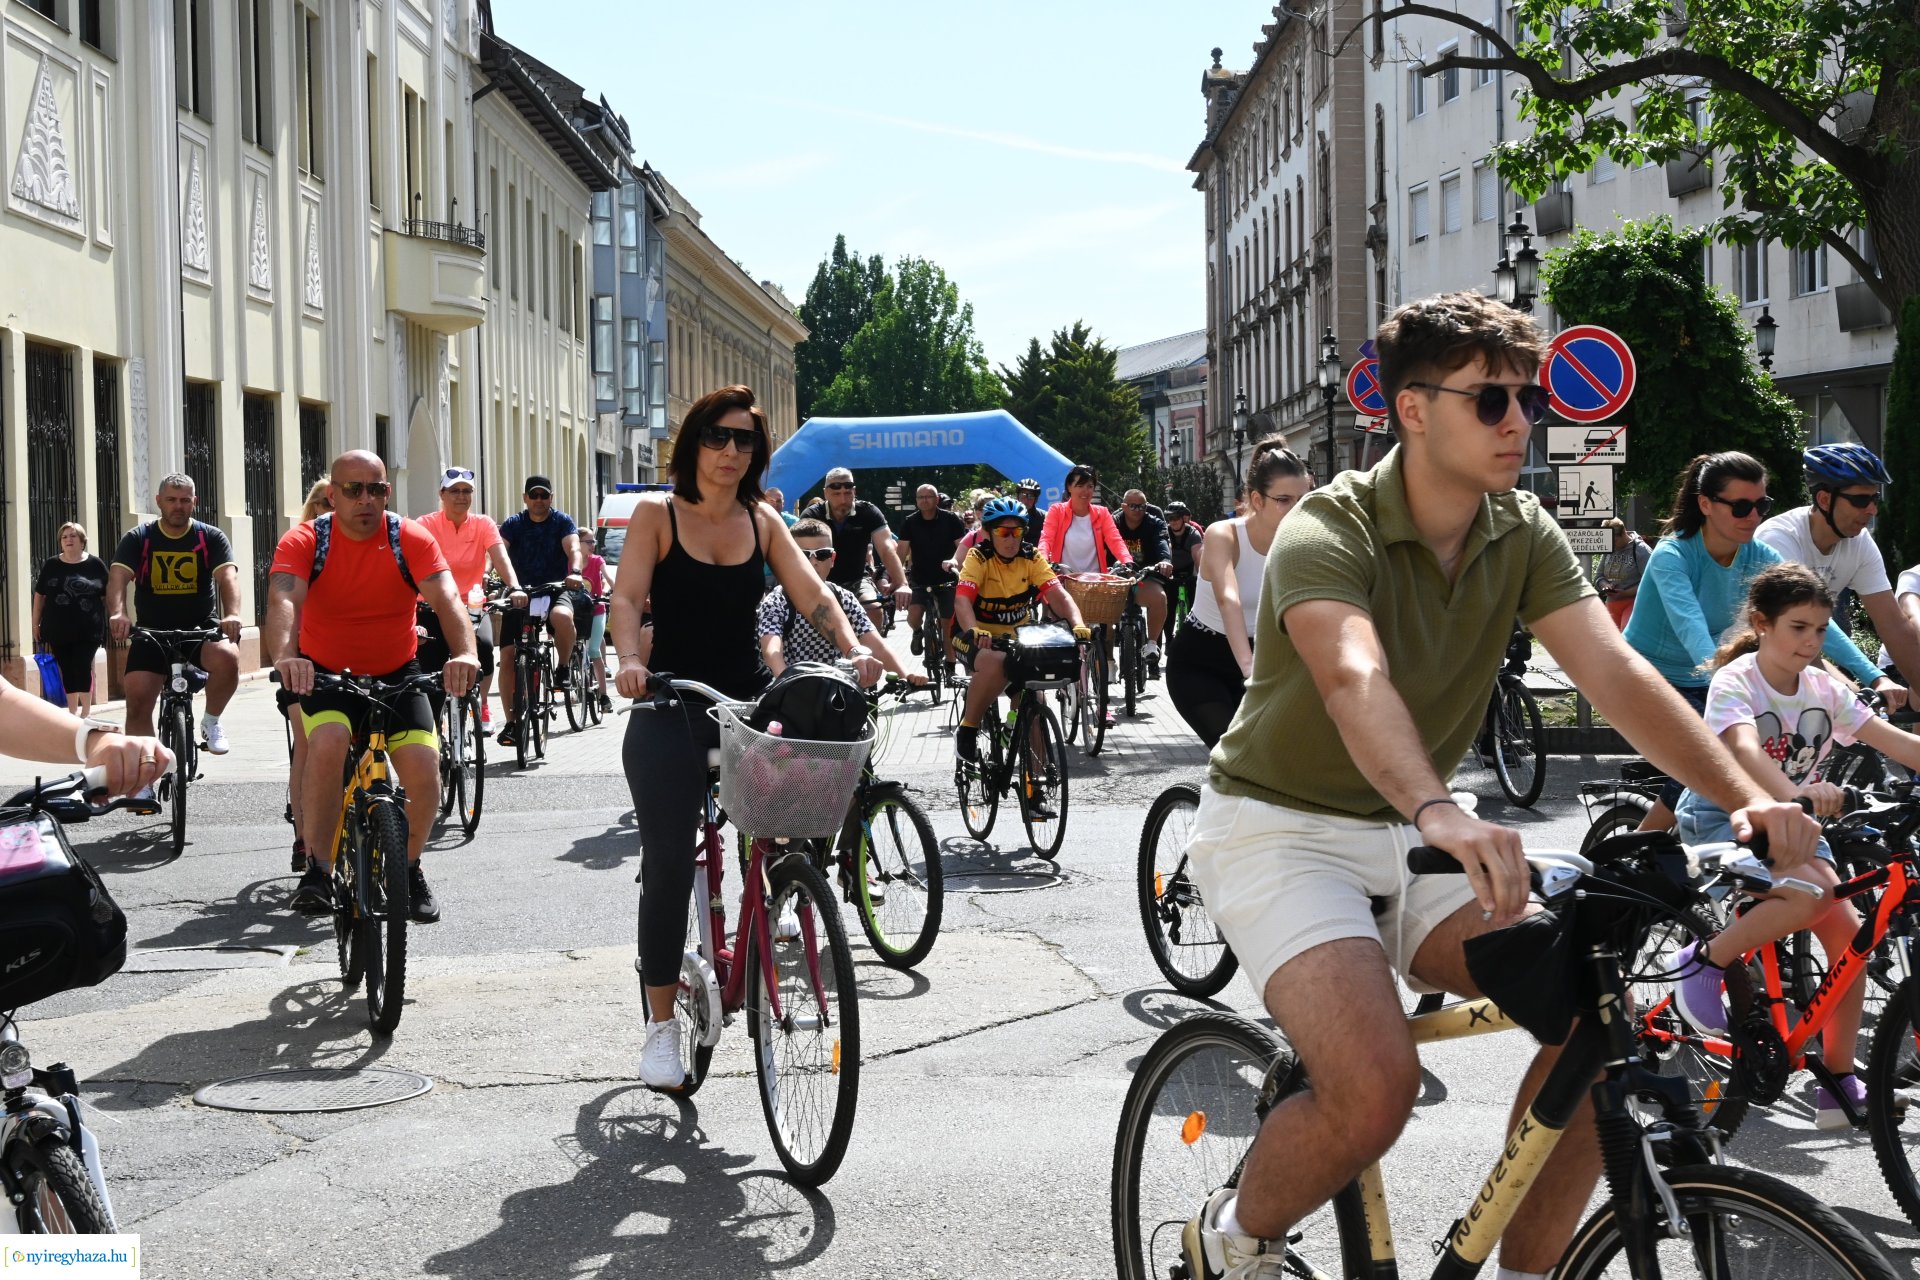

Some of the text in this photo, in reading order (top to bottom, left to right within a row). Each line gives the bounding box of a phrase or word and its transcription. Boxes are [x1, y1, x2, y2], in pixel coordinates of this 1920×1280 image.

[848, 429, 965, 450] SHIMANO
[156, 556, 193, 583] YC
[6, 947, 41, 973] KLS
[1456, 1118, 1535, 1247] NEUZER
